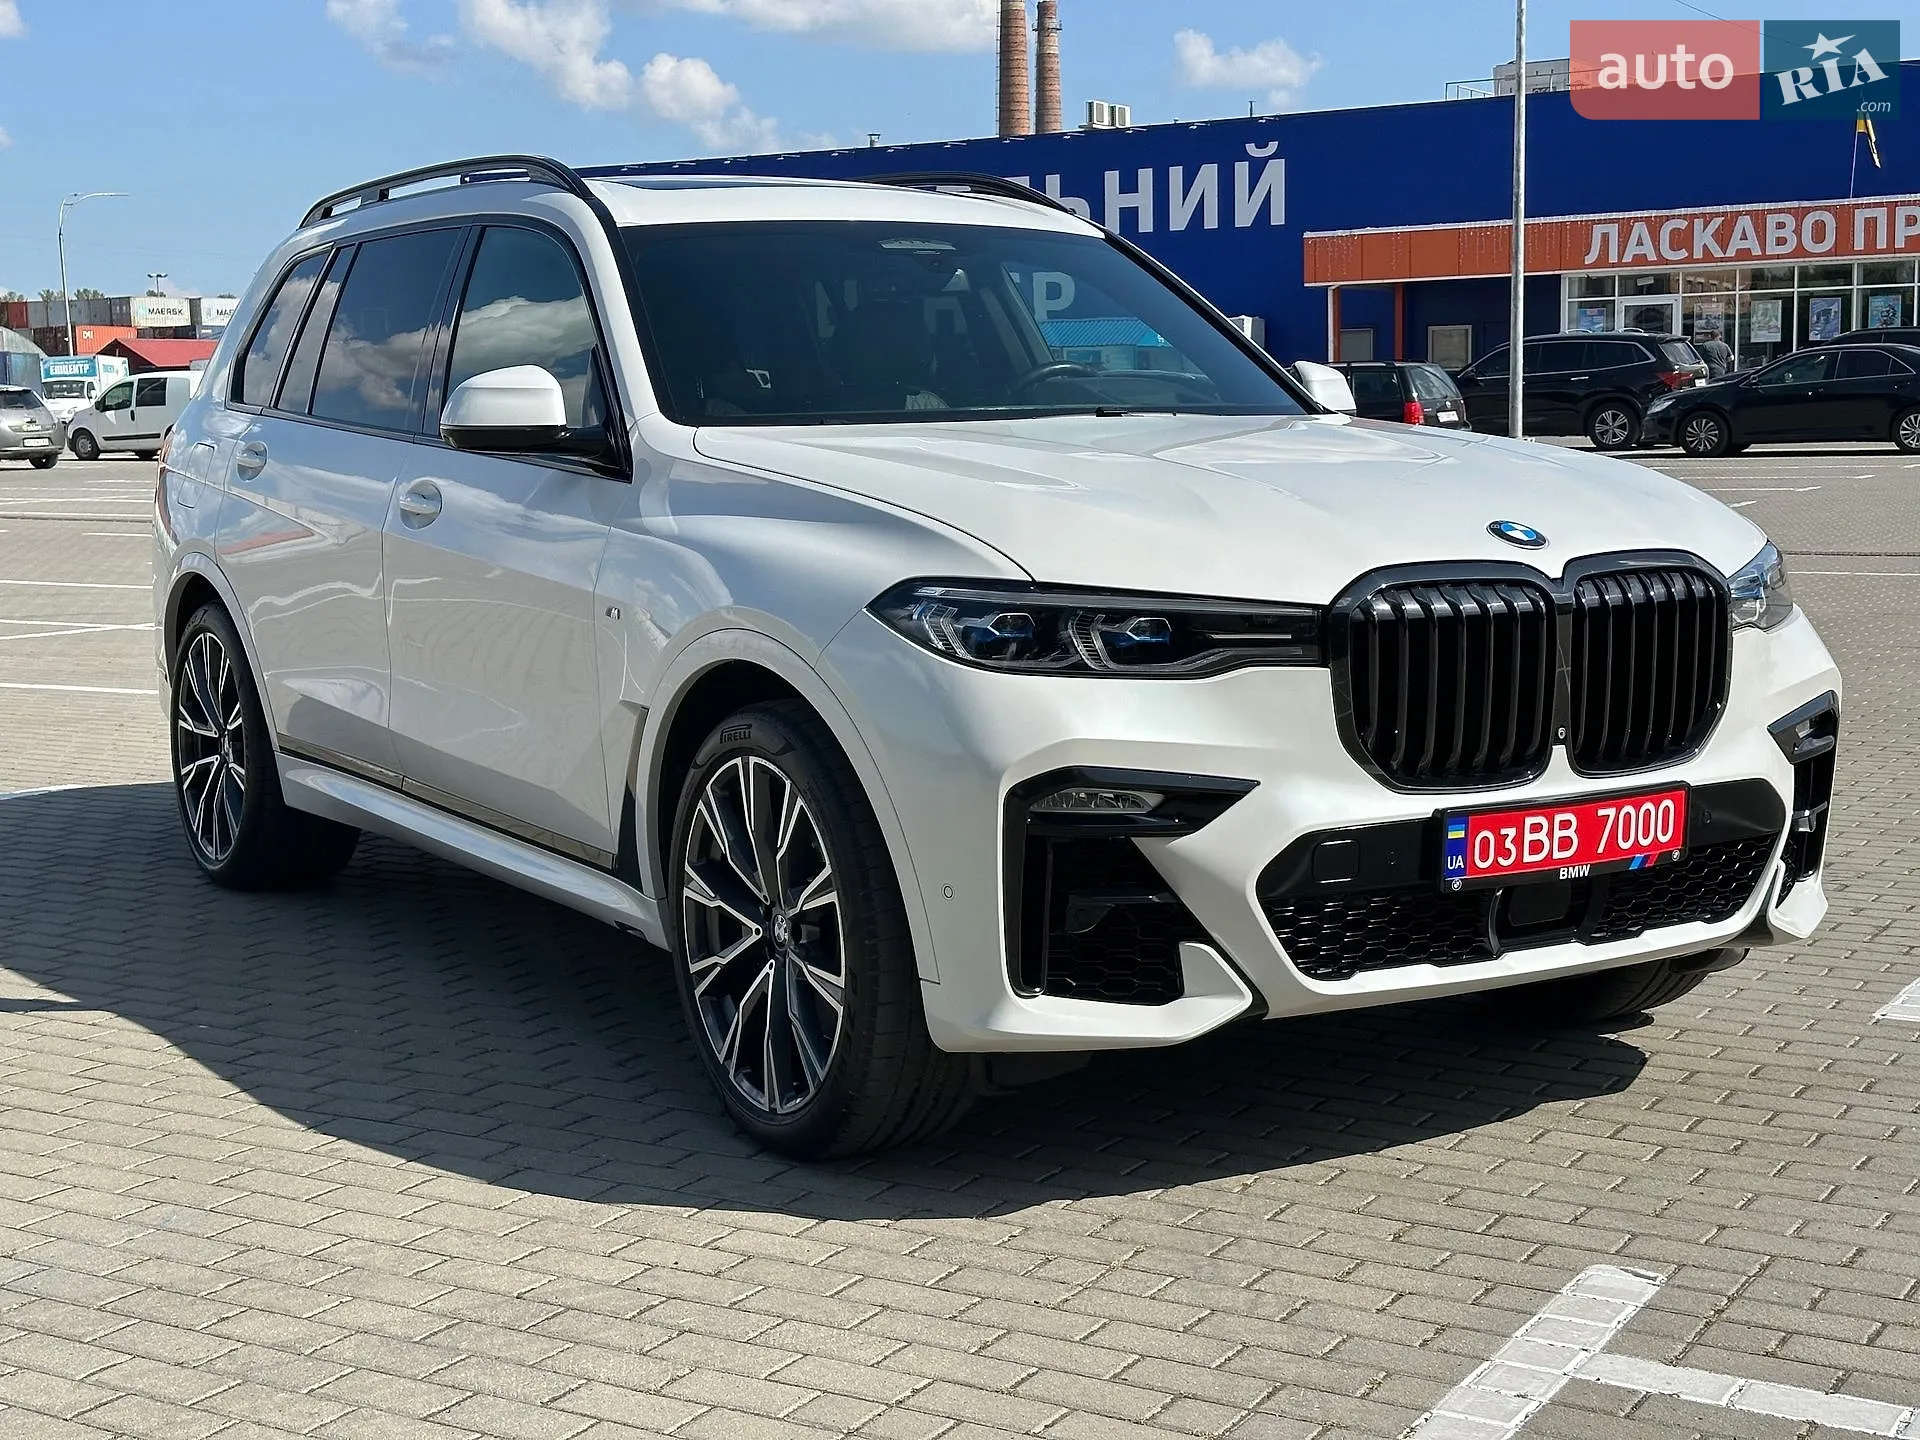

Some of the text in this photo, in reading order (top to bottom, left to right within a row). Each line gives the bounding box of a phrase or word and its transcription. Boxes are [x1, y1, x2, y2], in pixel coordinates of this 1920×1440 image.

[1001, 141, 1286, 235] ЬНИЙ
[1584, 210, 1837, 265] ЛАСКАВО
[148, 308, 184, 316] MAERSK
[720, 723, 752, 744] PIRELLI
[1597, 799, 1675, 854] 7000
[1447, 855, 1465, 870] UA
[1559, 864, 1591, 880] BMW
